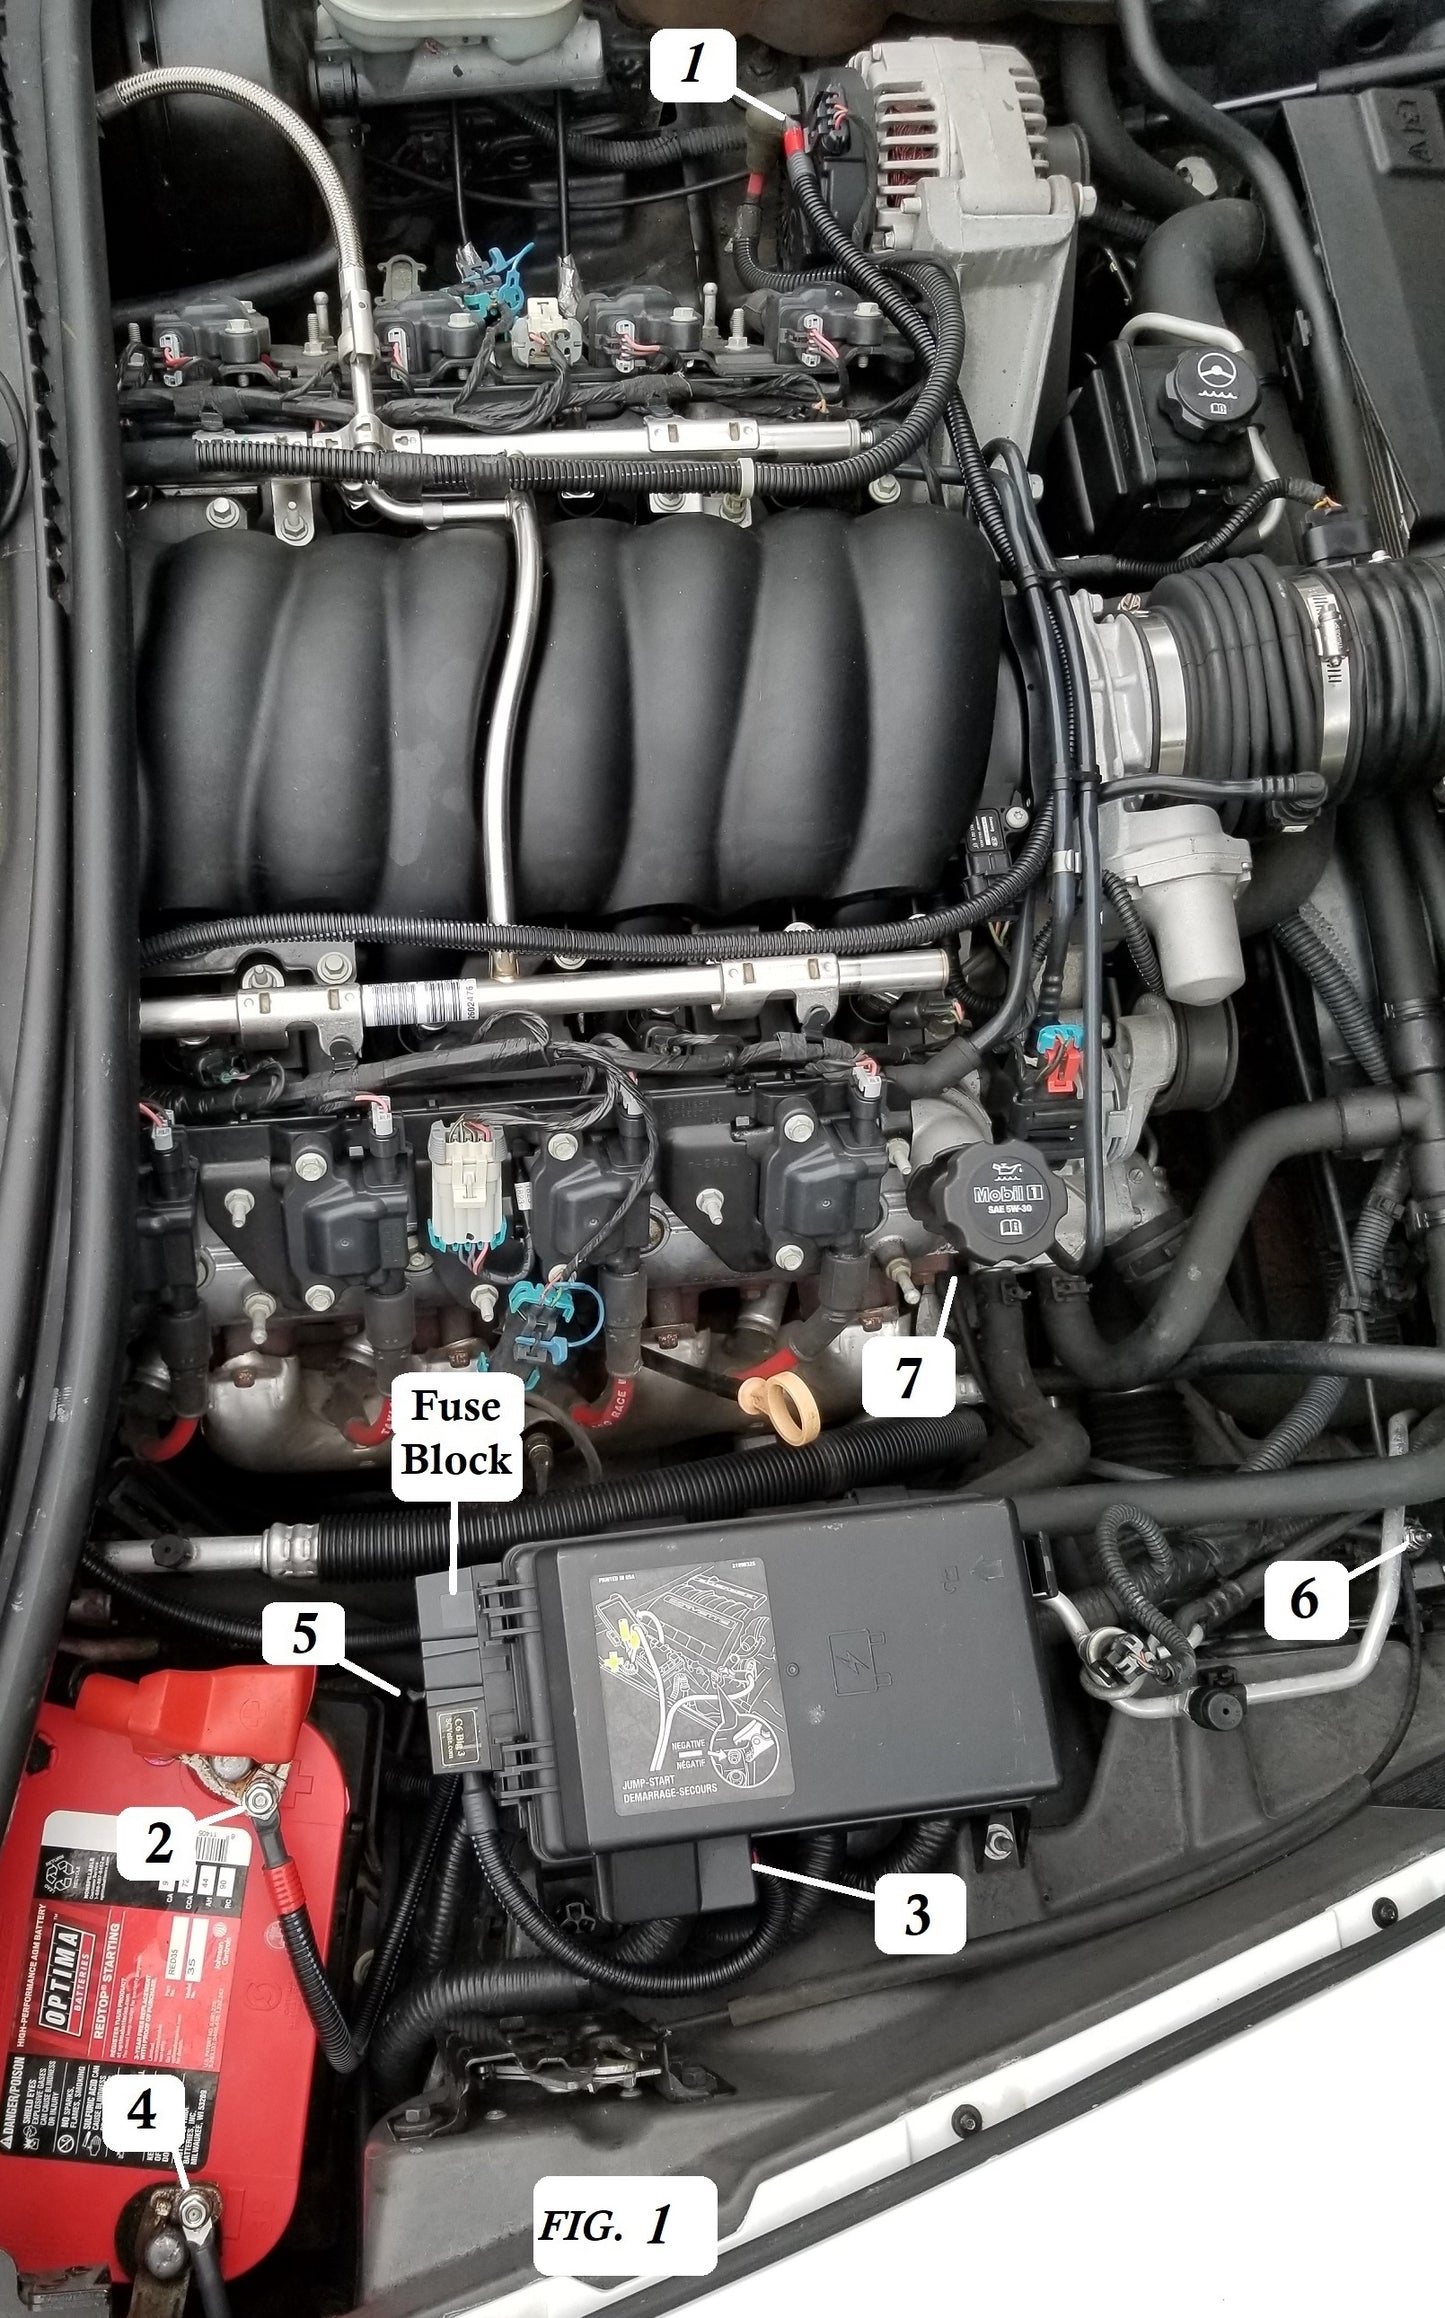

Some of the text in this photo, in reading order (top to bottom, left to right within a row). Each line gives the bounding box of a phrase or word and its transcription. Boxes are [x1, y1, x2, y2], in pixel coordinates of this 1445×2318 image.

[973, 1185, 1024, 1203] Mobil
[988, 1203, 1033, 1214] SAE 5W-30
[455, 1718, 464, 1732] C6
[671, 1739, 706, 1751] NEGATIVE
[622, 1774, 676, 1791] JUMP-START
[623, 1783, 718, 1804] DEMARRAGE-SECOURS
[166, 1893, 173, 1903] CA
[185, 1895, 194, 1910] CCA
[205, 1897, 213, 1908] AH
[224, 1899, 232, 1909] RC
[102, 1922, 120, 1983] STARTING
[214, 1941, 225, 1970] Johnson
[222, 1937, 232, 1966] Controls
[168, 1949, 178, 1975] RED35
[187, 1958, 196, 1975] 35
[17, 1962, 37, 2048] HIGH-PERFORMANCE
[33, 1903, 46, 1941] BATTERY
[45, 1931, 78, 2026] OPTIMA
[73, 1953, 89, 2012] BATTERIES
[74, 2066, 86, 2098] SMOKING
[88, 2079, 98, 2096] ACID
[2, 2056, 25, 2135] DANGER/POISON
[22, 2079, 37, 2125] SHIELD EYES
[31, 2068, 47, 2125] EXPLOSIVE GASES
[41, 2093, 51, 2113] CAUSE
[40, 2113, 48, 2126] CAN
[48, 2115, 56, 2127] OR
[61, 2116, 70, 2128] NO
[83, 2096, 95, 2130] SULFURIC
